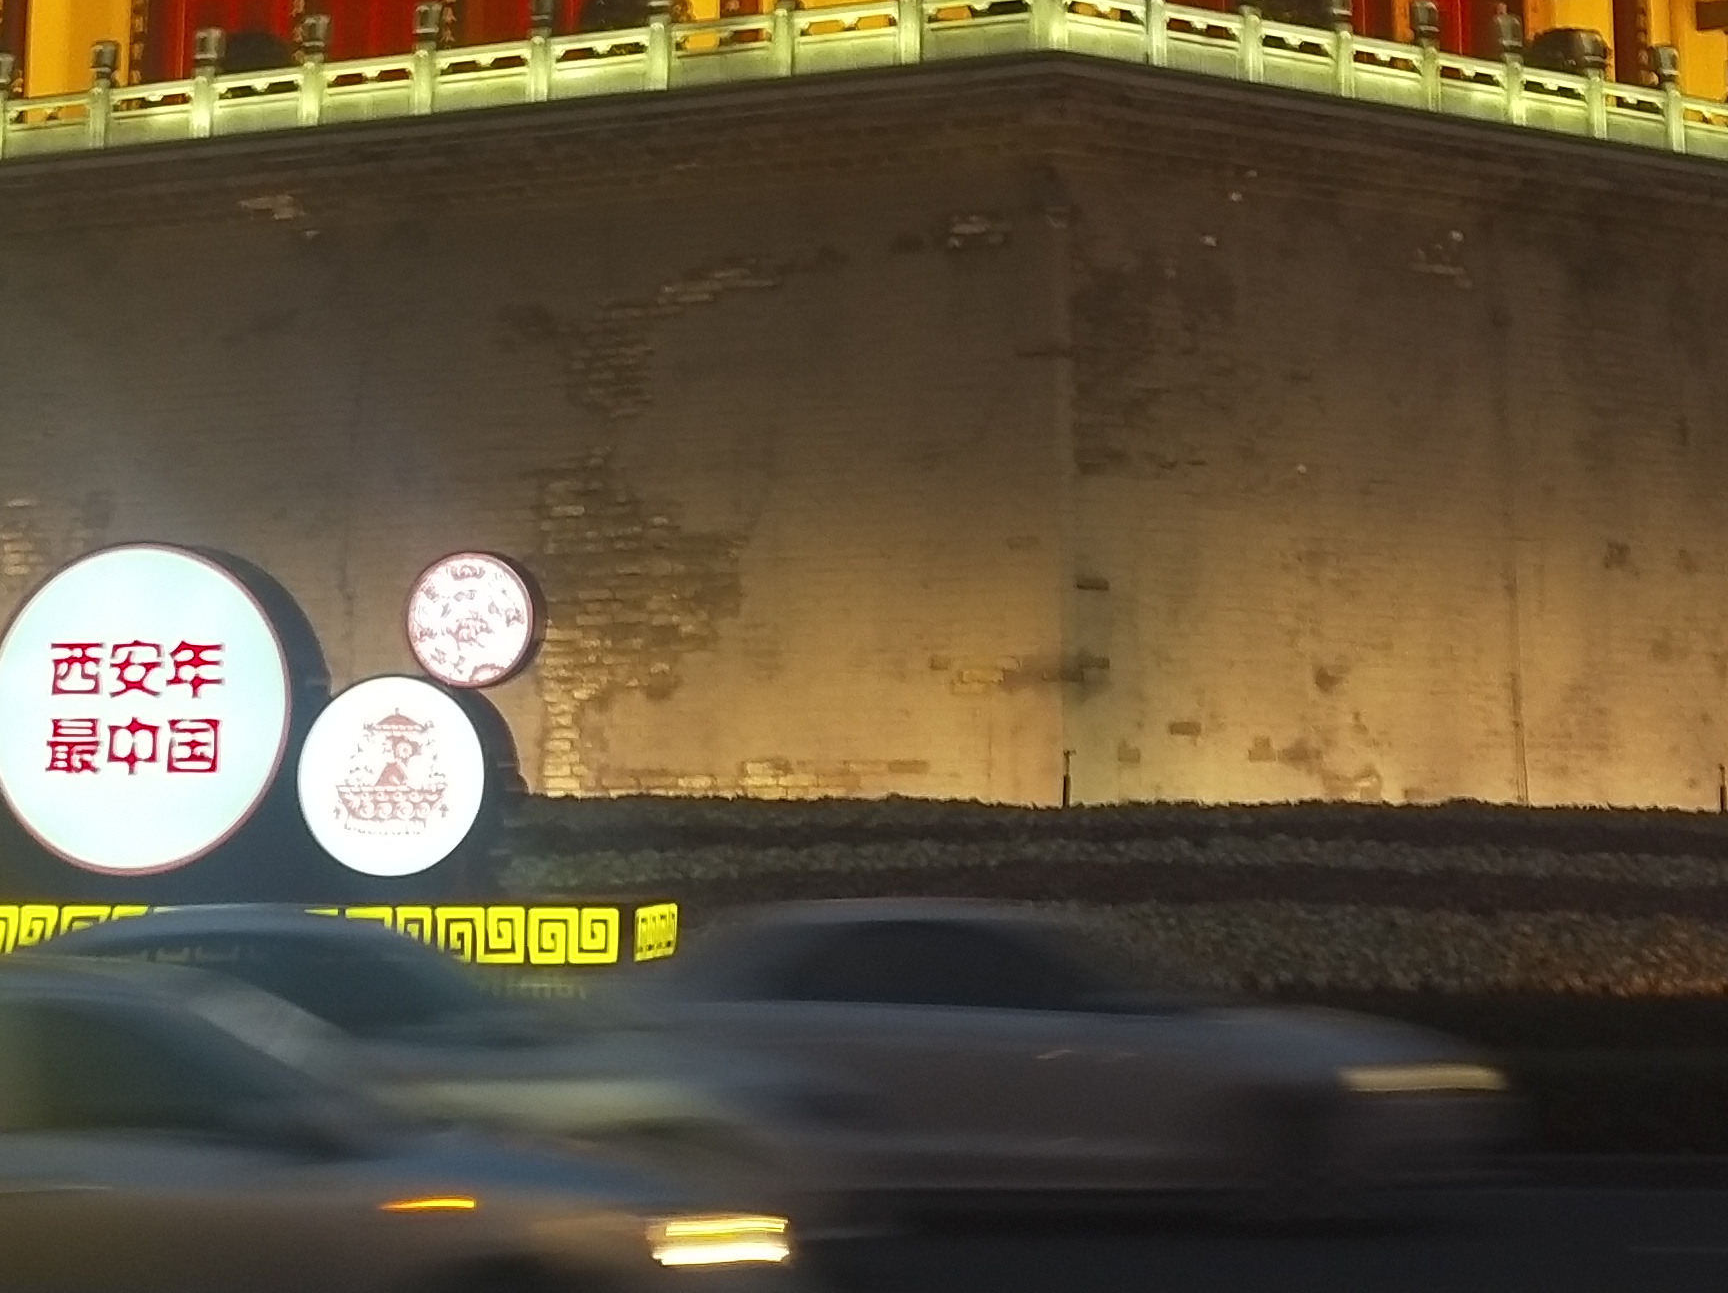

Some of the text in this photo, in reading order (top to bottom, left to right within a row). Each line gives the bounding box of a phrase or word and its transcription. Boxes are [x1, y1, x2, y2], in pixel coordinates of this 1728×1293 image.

[51, 639, 224, 698] 西安年
[46, 717, 220, 775] 最中国
